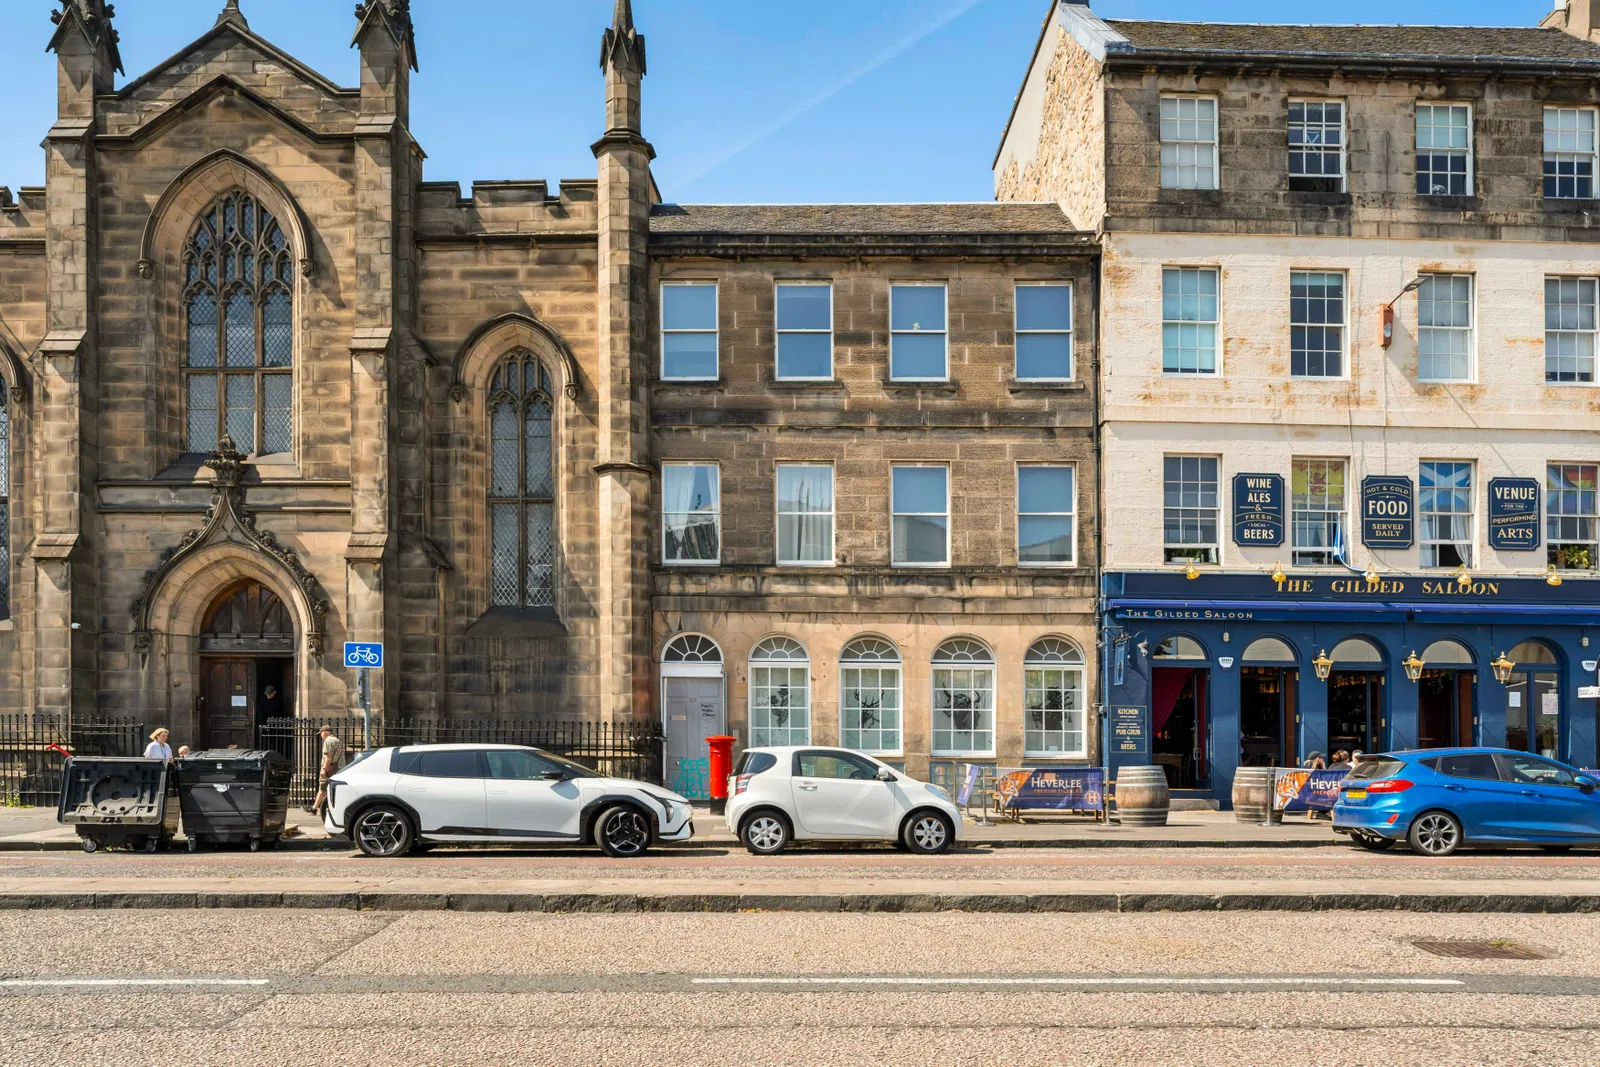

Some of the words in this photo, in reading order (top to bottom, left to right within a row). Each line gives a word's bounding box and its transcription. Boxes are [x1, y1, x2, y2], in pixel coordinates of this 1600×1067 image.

[1246, 478, 1272, 489] WINE
[1366, 486, 1380, 494] HOT
[1389, 486, 1409, 495] COLD
[1495, 487, 1535, 500] VENUE
[1247, 493, 1271, 503] ALES
[1368, 500, 1408, 515] FOOD
[1492, 514, 1536, 524] PERFORMING
[1244, 529, 1274, 540] BEERS
[1497, 528, 1533, 539] ARTS
[1276, 579, 1314, 593] THE
[1331, 580, 1405, 595] GILDED
[1421, 581, 1500, 596] SALOON
[1126, 609, 1149, 617] THE
[1154, 609, 1199, 618] GILDED
[1204, 610, 1253, 619] SALOON
[1031, 777, 1082, 789] HEVERLEE
